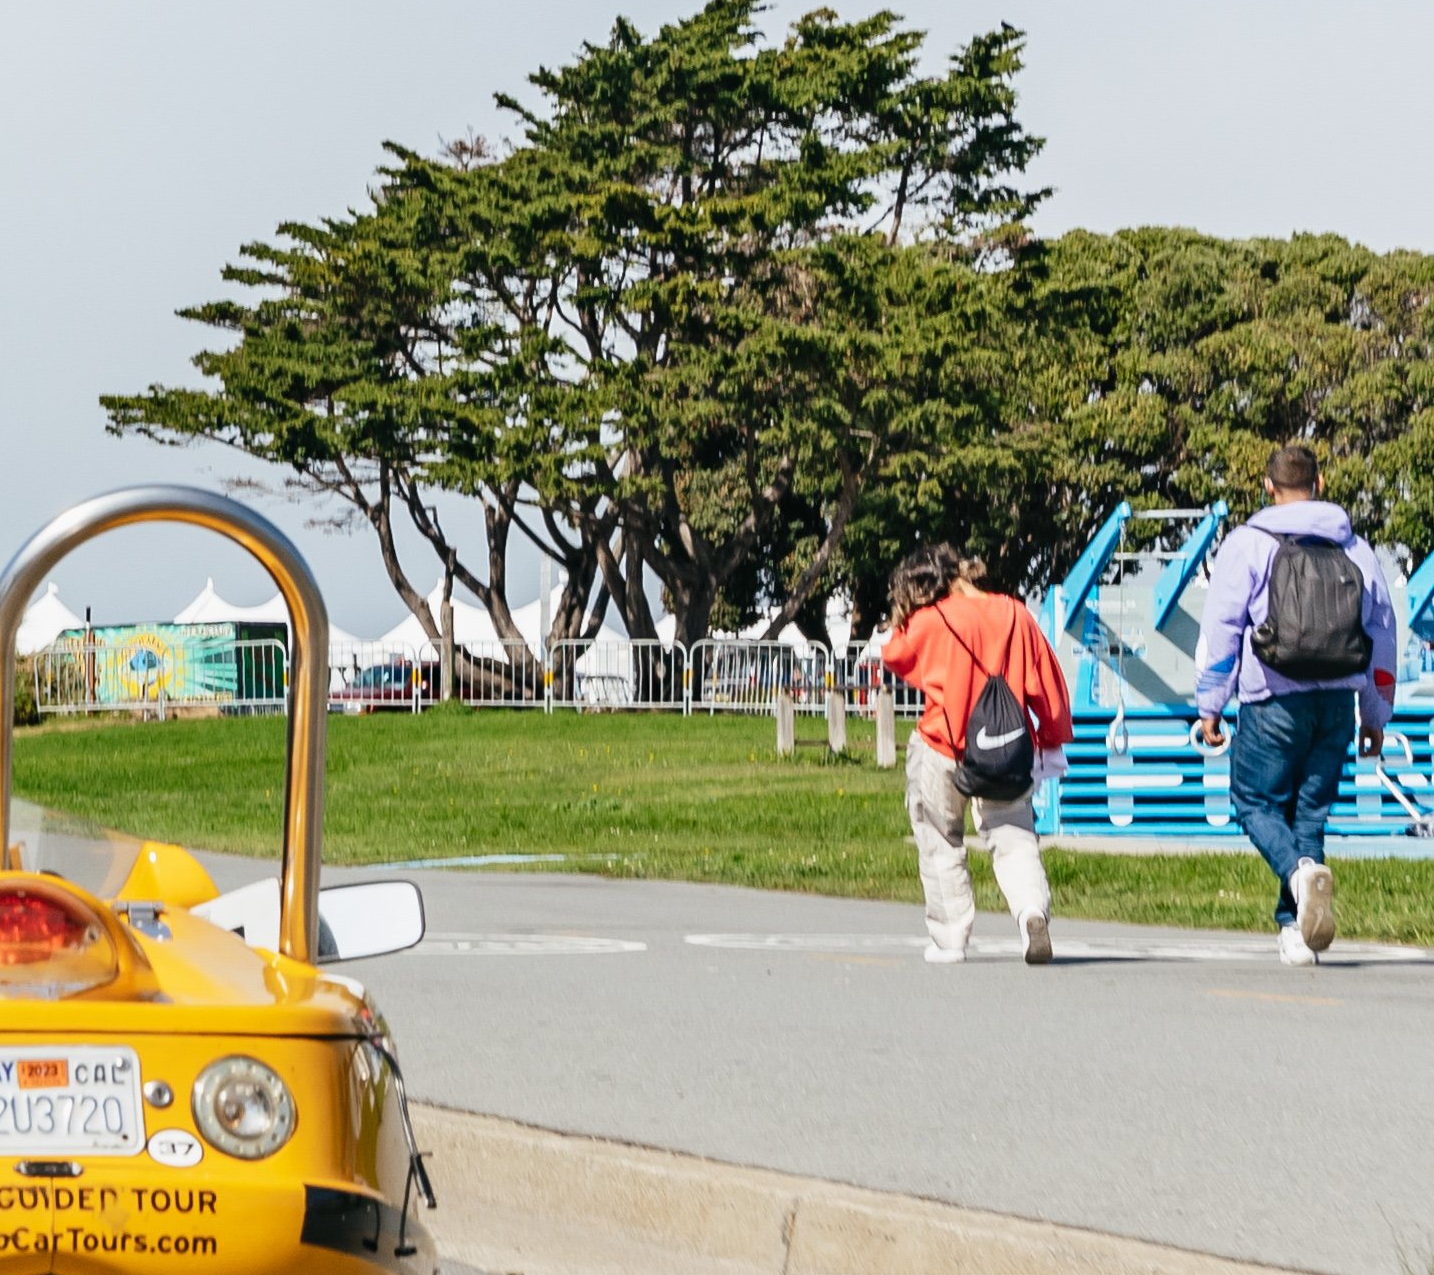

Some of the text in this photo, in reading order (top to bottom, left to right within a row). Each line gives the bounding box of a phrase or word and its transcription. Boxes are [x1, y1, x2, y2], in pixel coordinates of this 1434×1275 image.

[28, 1066, 58, 1078] 2023
[75, 1063, 125, 1085] CAL
[131, 1189, 217, 1214] TOUR
